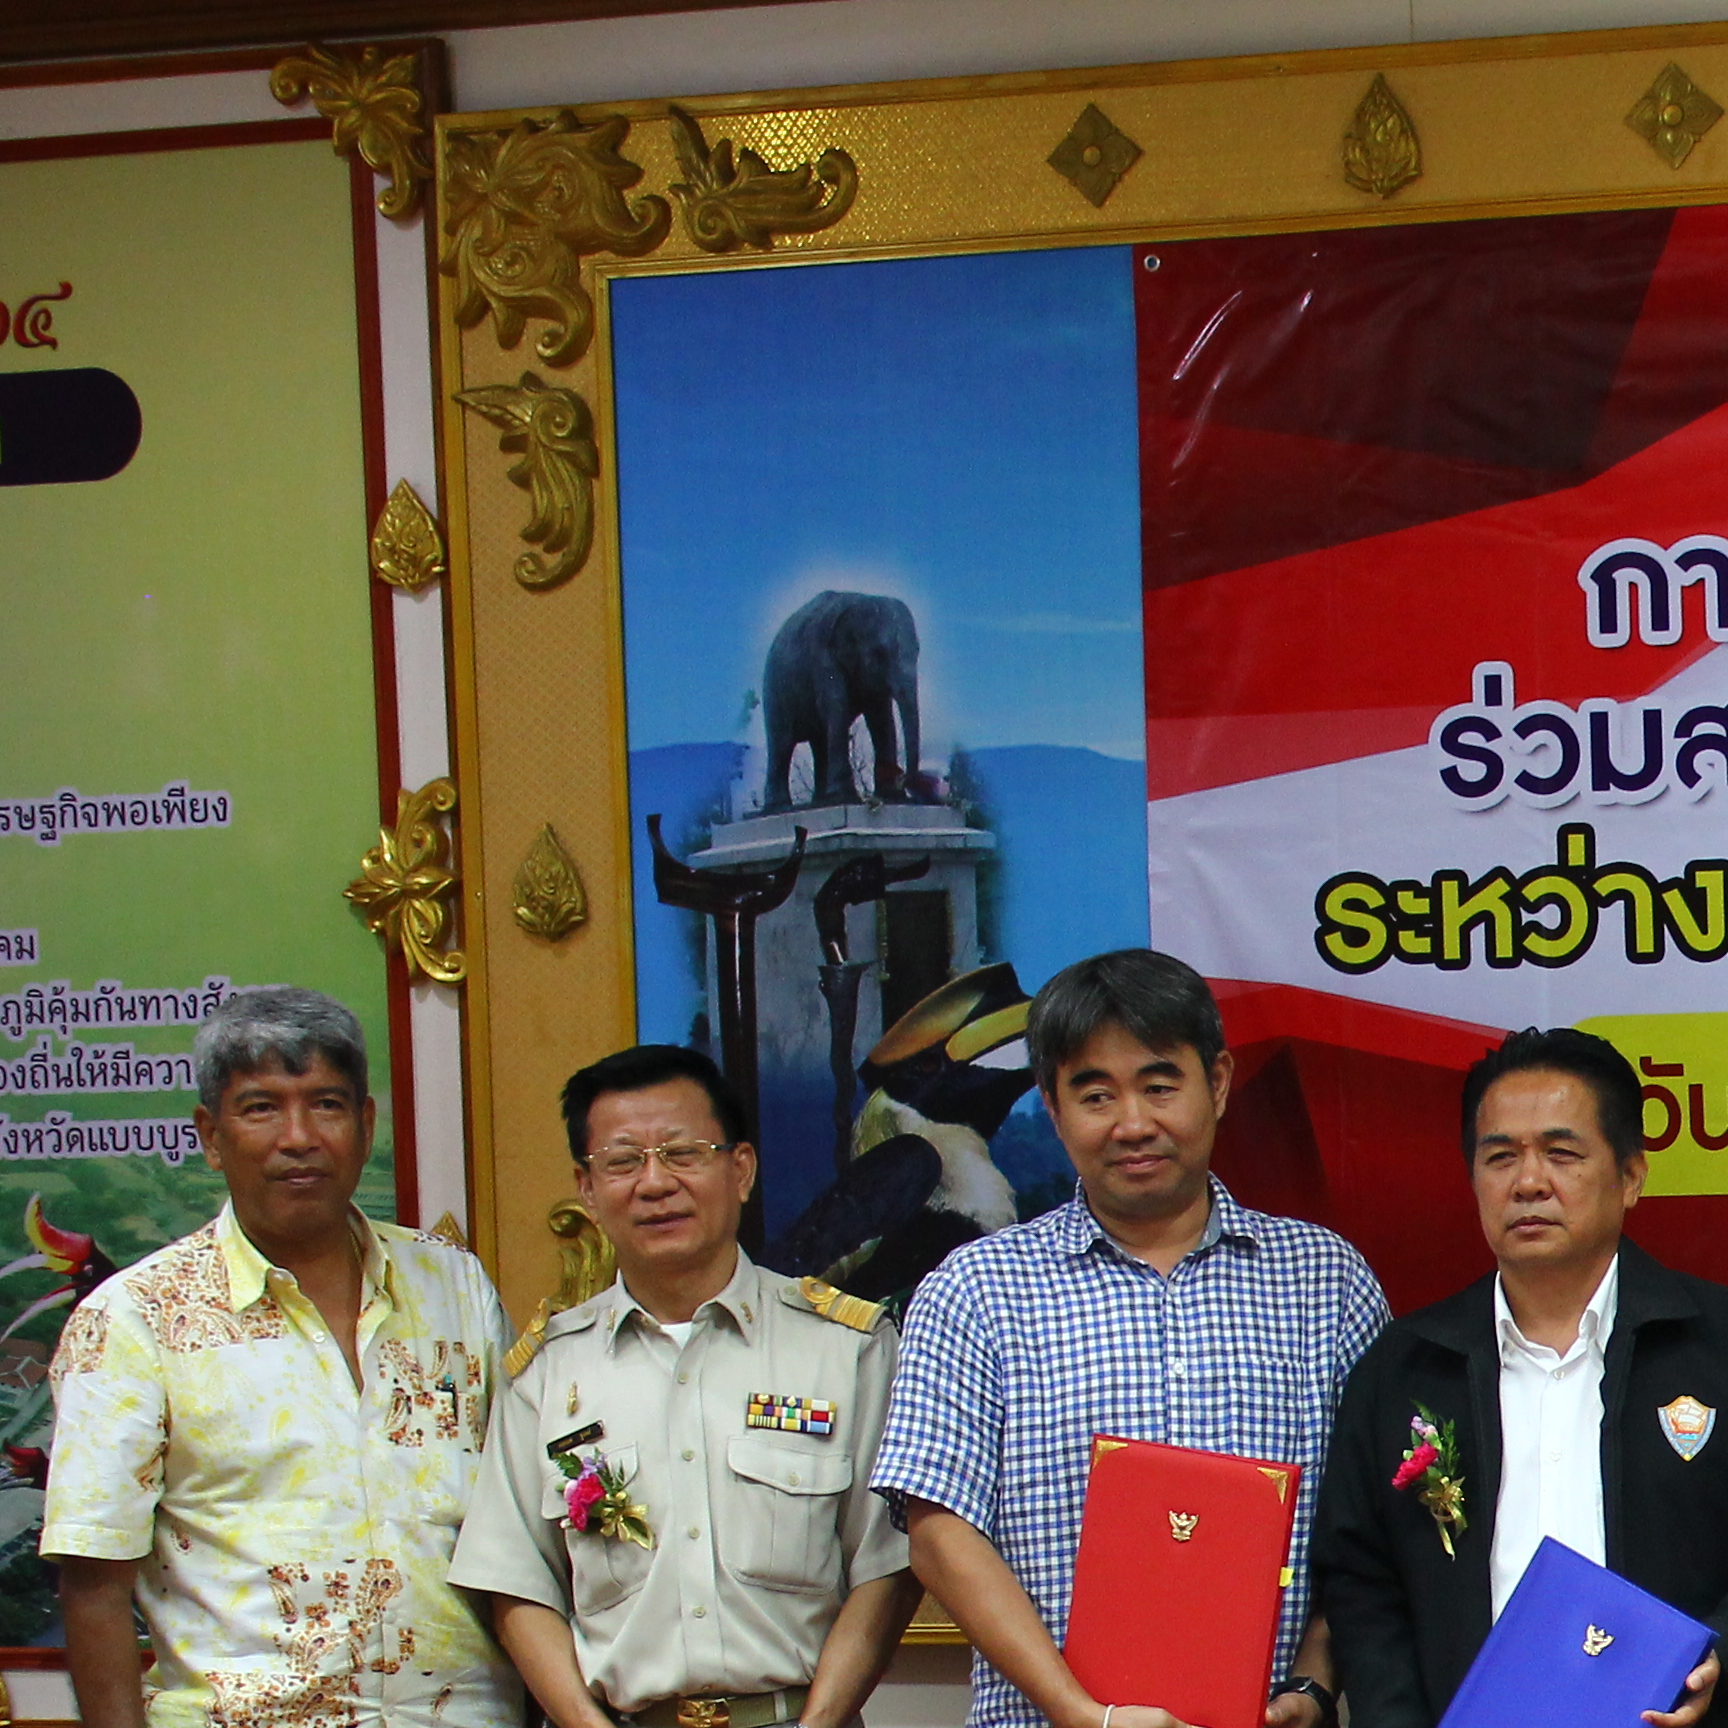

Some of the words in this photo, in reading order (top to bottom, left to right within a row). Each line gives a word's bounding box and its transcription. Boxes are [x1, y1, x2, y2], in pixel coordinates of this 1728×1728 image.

[0, 981, 228, 1037] ภูมิคุ้มกันทางสั
